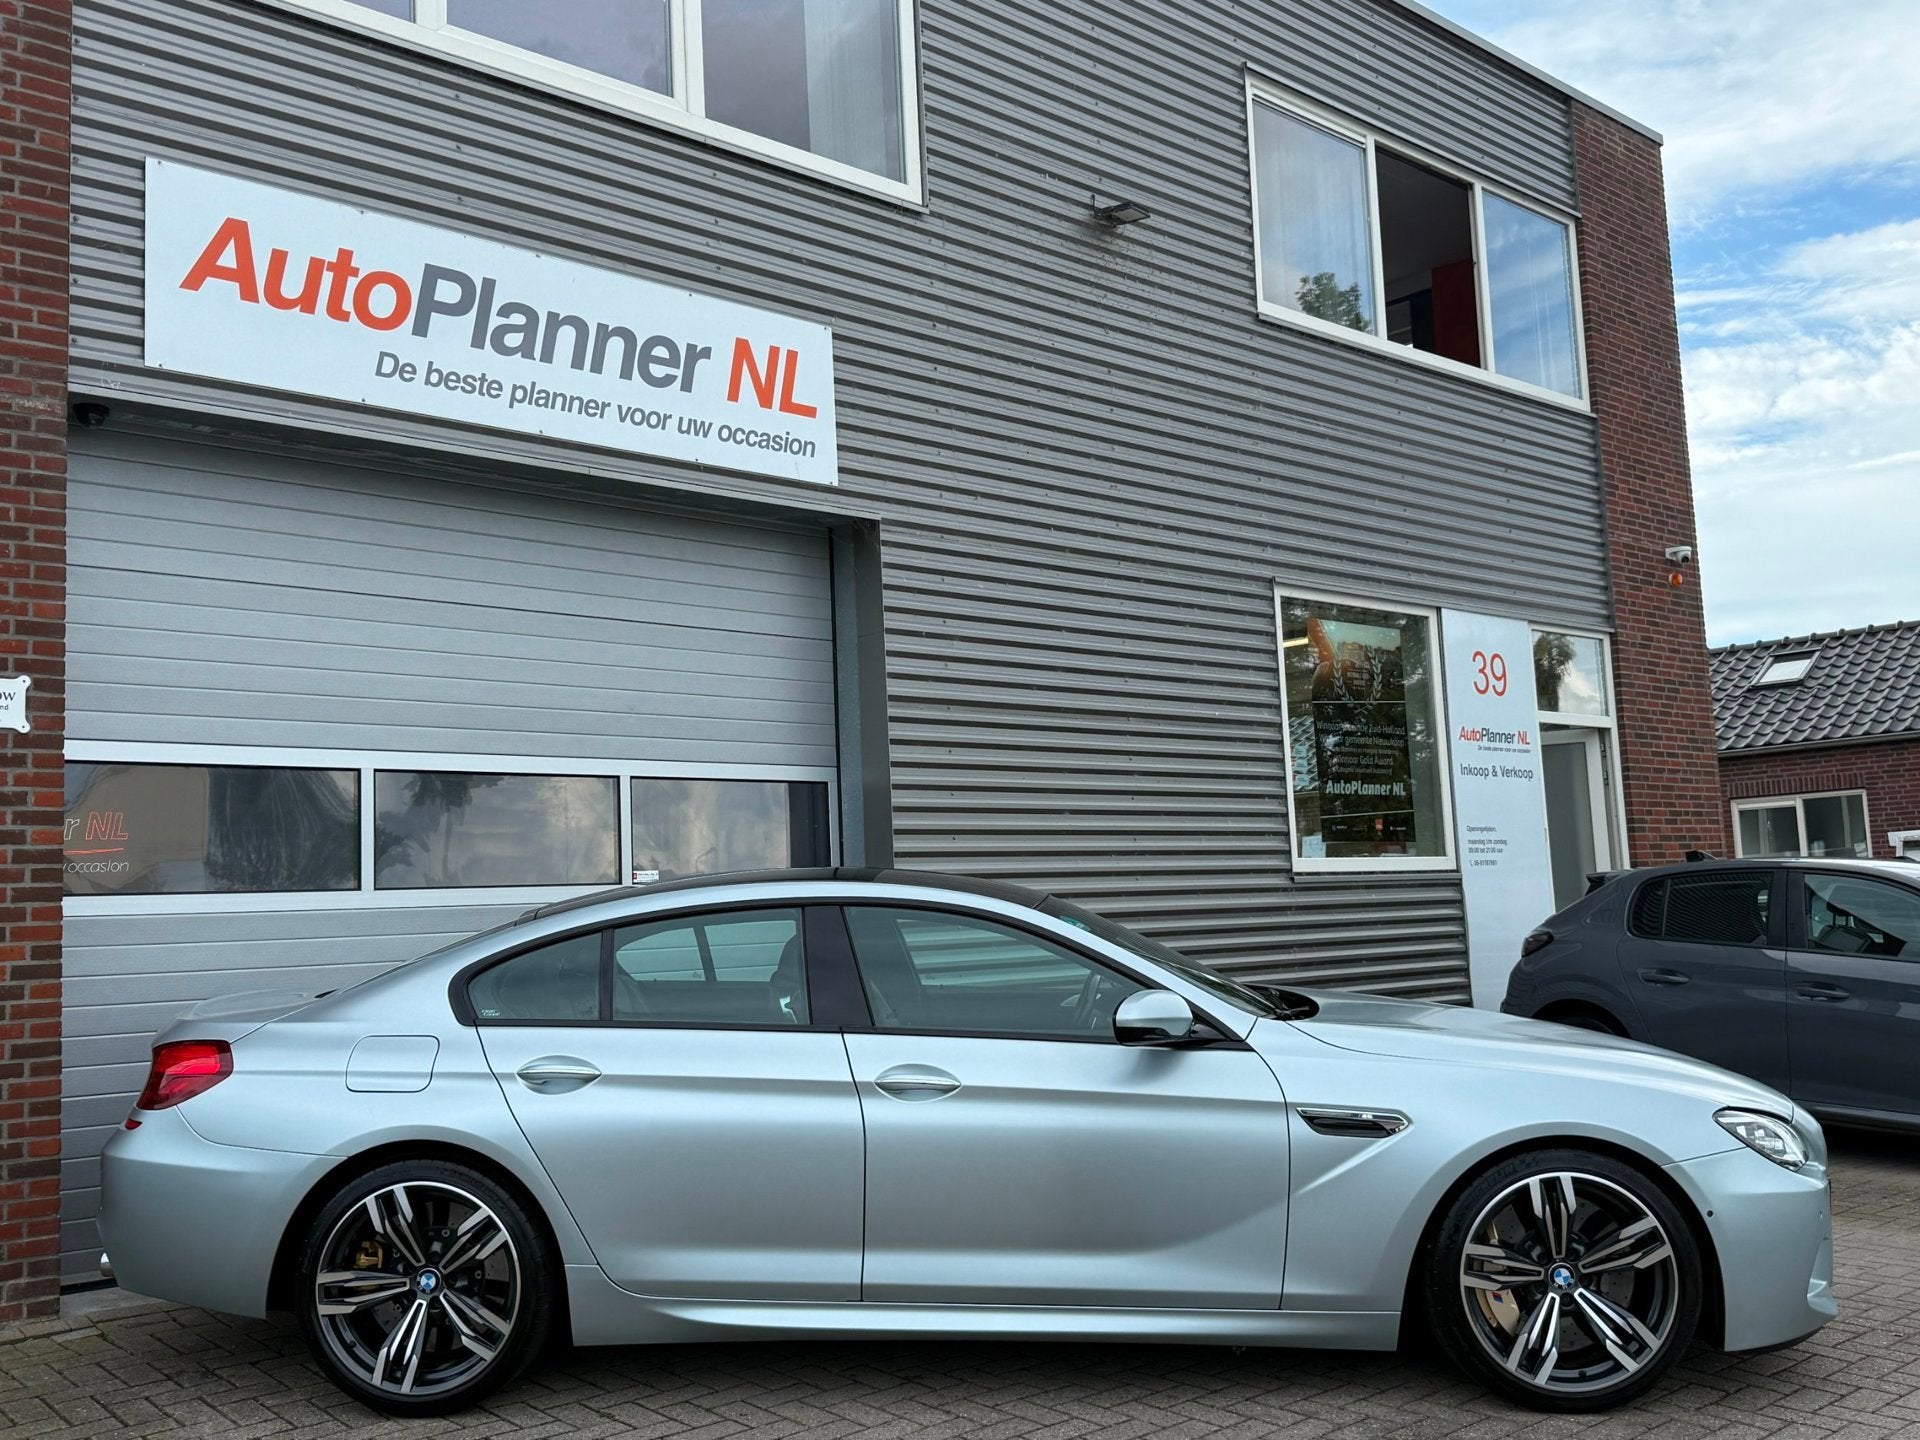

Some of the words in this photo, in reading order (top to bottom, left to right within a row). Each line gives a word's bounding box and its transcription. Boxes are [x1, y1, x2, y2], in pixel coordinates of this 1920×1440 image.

[179, 217, 712, 393] AutoPlanner
[727, 337, 818, 419] NL
[375, 351, 417, 382] De
[424, 361, 503, 399] beste
[509, 381, 610, 418] planner
[617, 404, 672, 431] voor
[677, 416, 713, 439] uw
[717, 424, 816, 458] occasion
[1472, 651, 1507, 697] 39
[1459, 726, 1515, 744] AutoPlanner
[1517, 730, 1531, 745] NL
[1460, 763, 1489, 780] Inkoop
[1492, 765, 1498, 777] &
[1500, 765, 1534, 781] Verkoop
[1326, 780, 1391, 796] AutoPlanner
[1393, 782, 1406, 796] NL
[86, 812, 128, 840] NL
[68, 859, 129, 873] occasion
